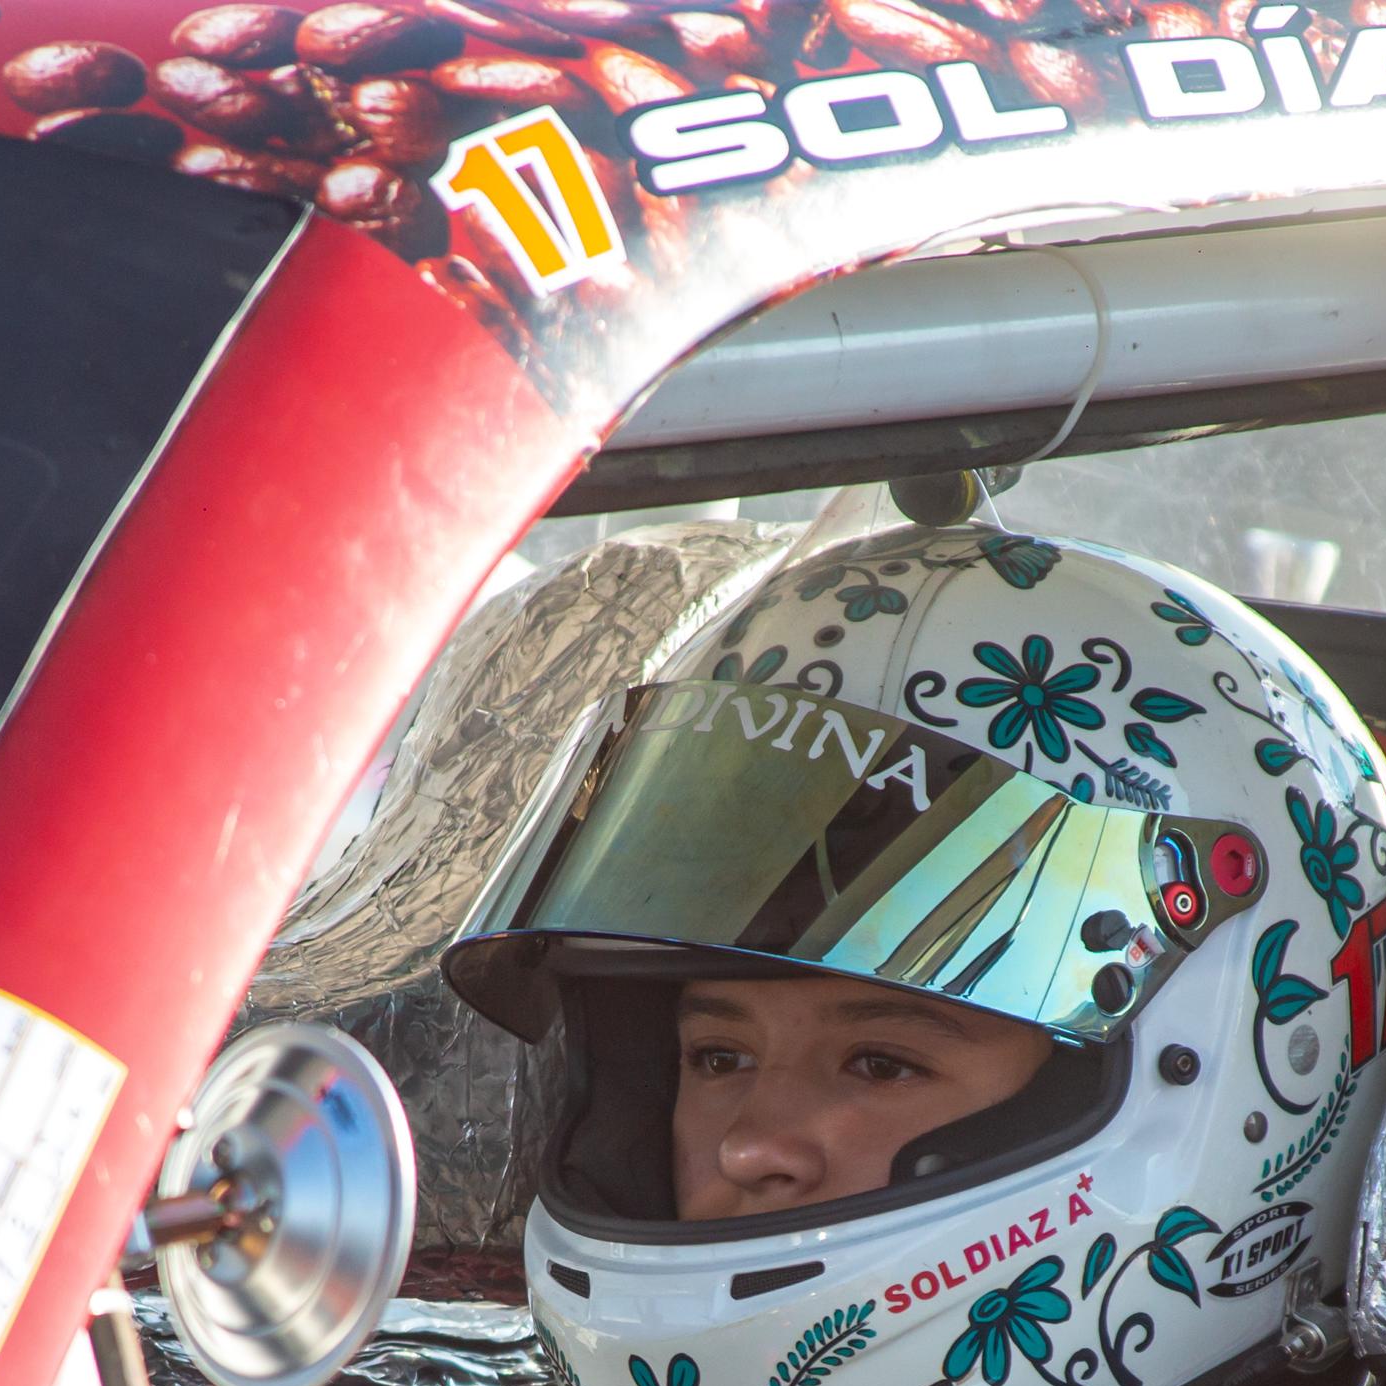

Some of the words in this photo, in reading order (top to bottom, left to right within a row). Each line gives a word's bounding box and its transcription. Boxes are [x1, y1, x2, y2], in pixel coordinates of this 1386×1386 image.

[630, 61, 1068, 192] SOL
[431, 106, 627, 298] 17
[641, 680, 931, 812] DIVINA
[884, 1261, 967, 1313] SOL
[963, 1208, 1057, 1275] DIAZ
[1068, 1172, 1094, 1226] A+
[1233, 1205, 1291, 1239] SPORT
[1235, 1262, 1290, 1295] SERIES
[1247, 1217, 1305, 1268] SPORT
